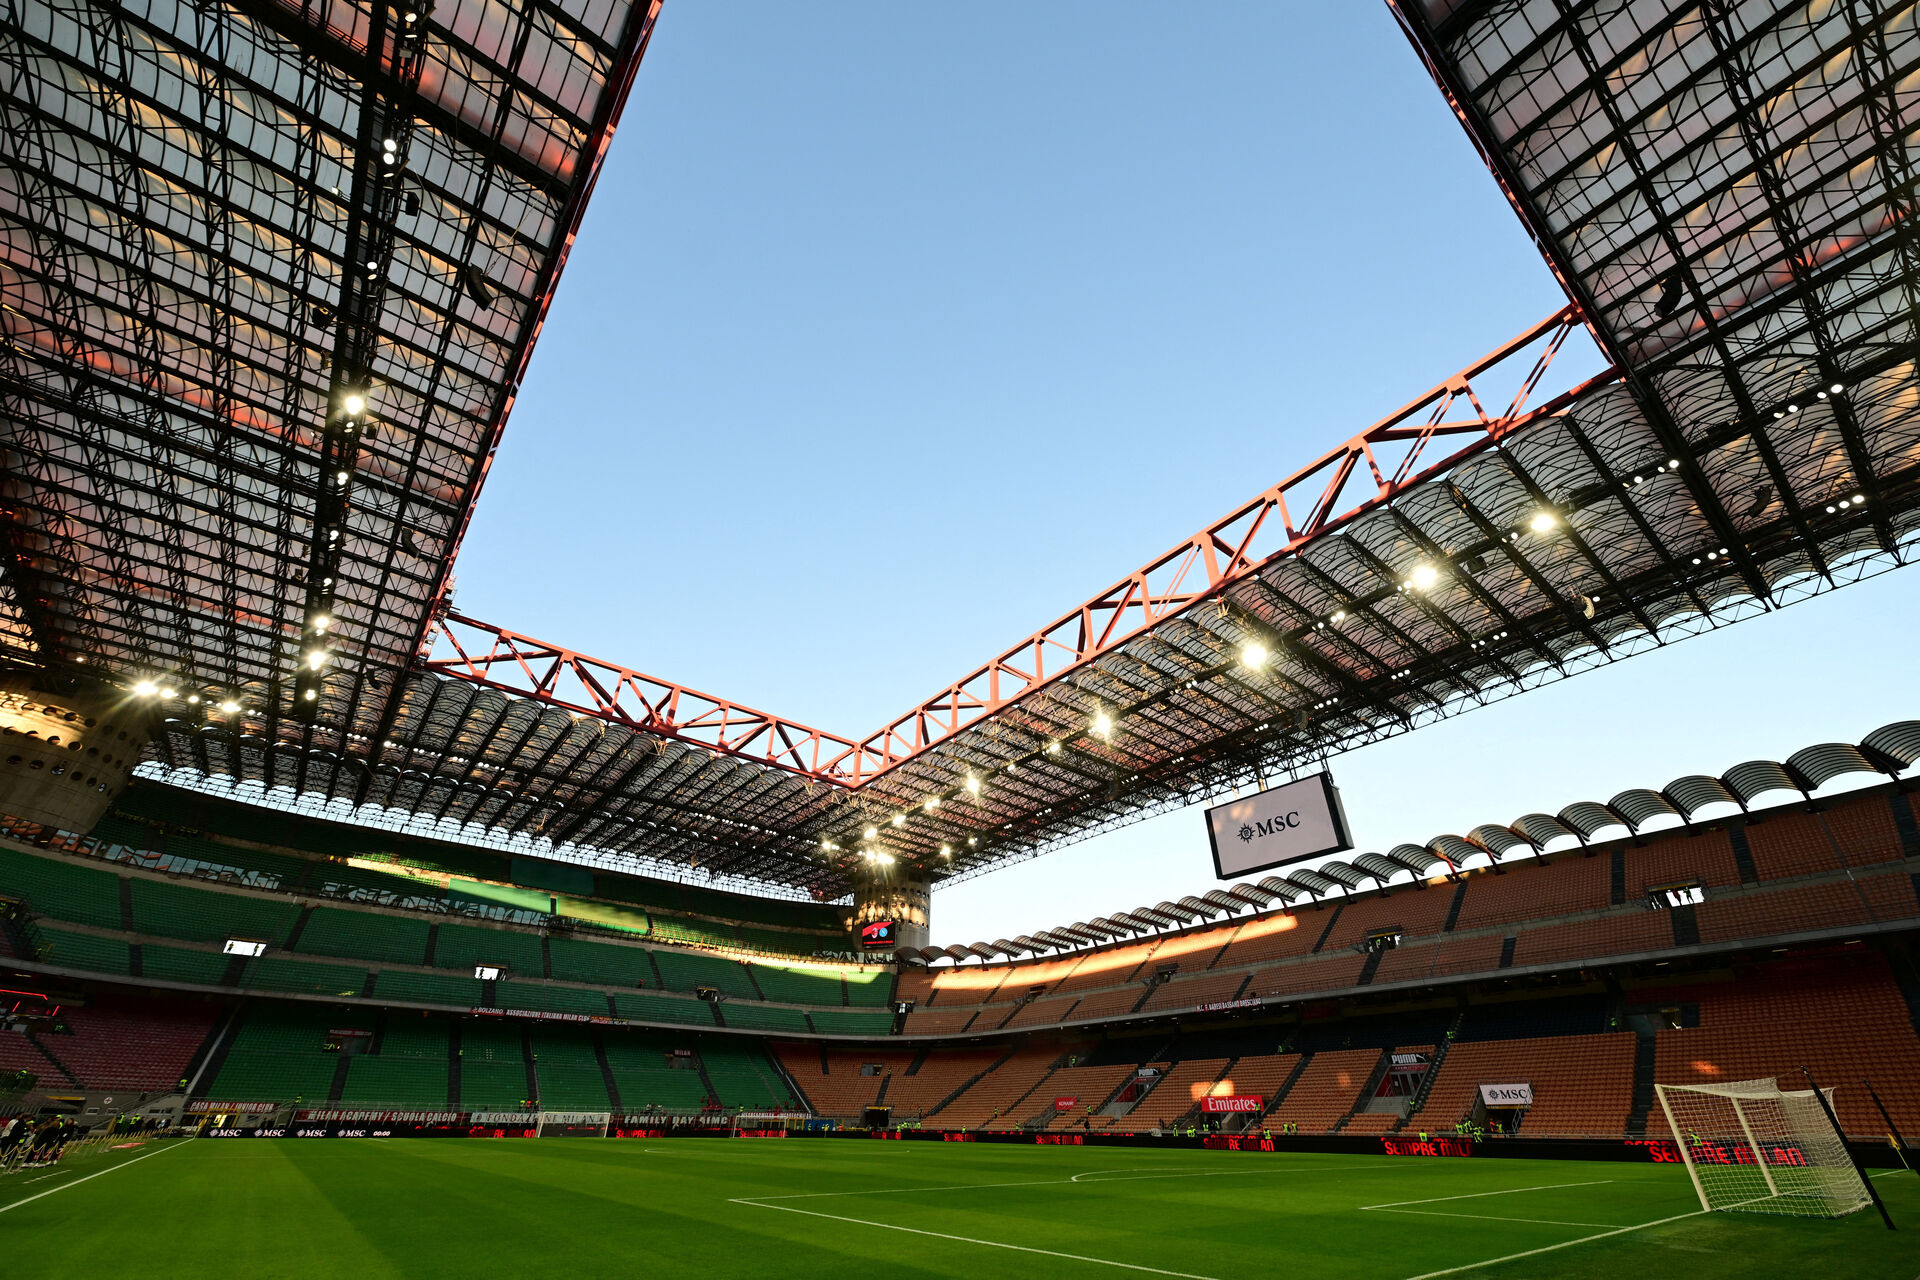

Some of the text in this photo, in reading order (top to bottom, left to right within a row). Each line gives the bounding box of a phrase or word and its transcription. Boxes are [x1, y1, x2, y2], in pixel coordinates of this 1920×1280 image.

[1256, 811, 1301, 838] MSC
[478, 1007, 504, 1015] BOLZANO
[506, 1009, 541, 1018] ASSOCIAZIONE
[541, 1011, 562, 1020] ITALIANA
[1391, 1053, 1417, 1064] PUMA
[1500, 1089, 1528, 1100] MSC
[189, 1101, 209, 1112] CASA
[256, 1103, 275, 1113] CLUB
[1208, 1096, 1257, 1111] Emirates
[307, 1111, 339, 1120] MILAN
[340, 1111, 384, 1121] ACADEMY
[391, 1112, 426, 1122] SCUOLA
[426, 1112, 458, 1122] CALCIO
[624, 1115, 667, 1124] FAMILY
[672, 1116, 695, 1124] DAY
[218, 1129, 242, 1137] MSC
[262, 1129, 286, 1137] MSC
[304, 1129, 327, 1137] MSC
[345, 1129, 367, 1137] MSC
[1385, 1142, 1438, 1156] SEMPRE
